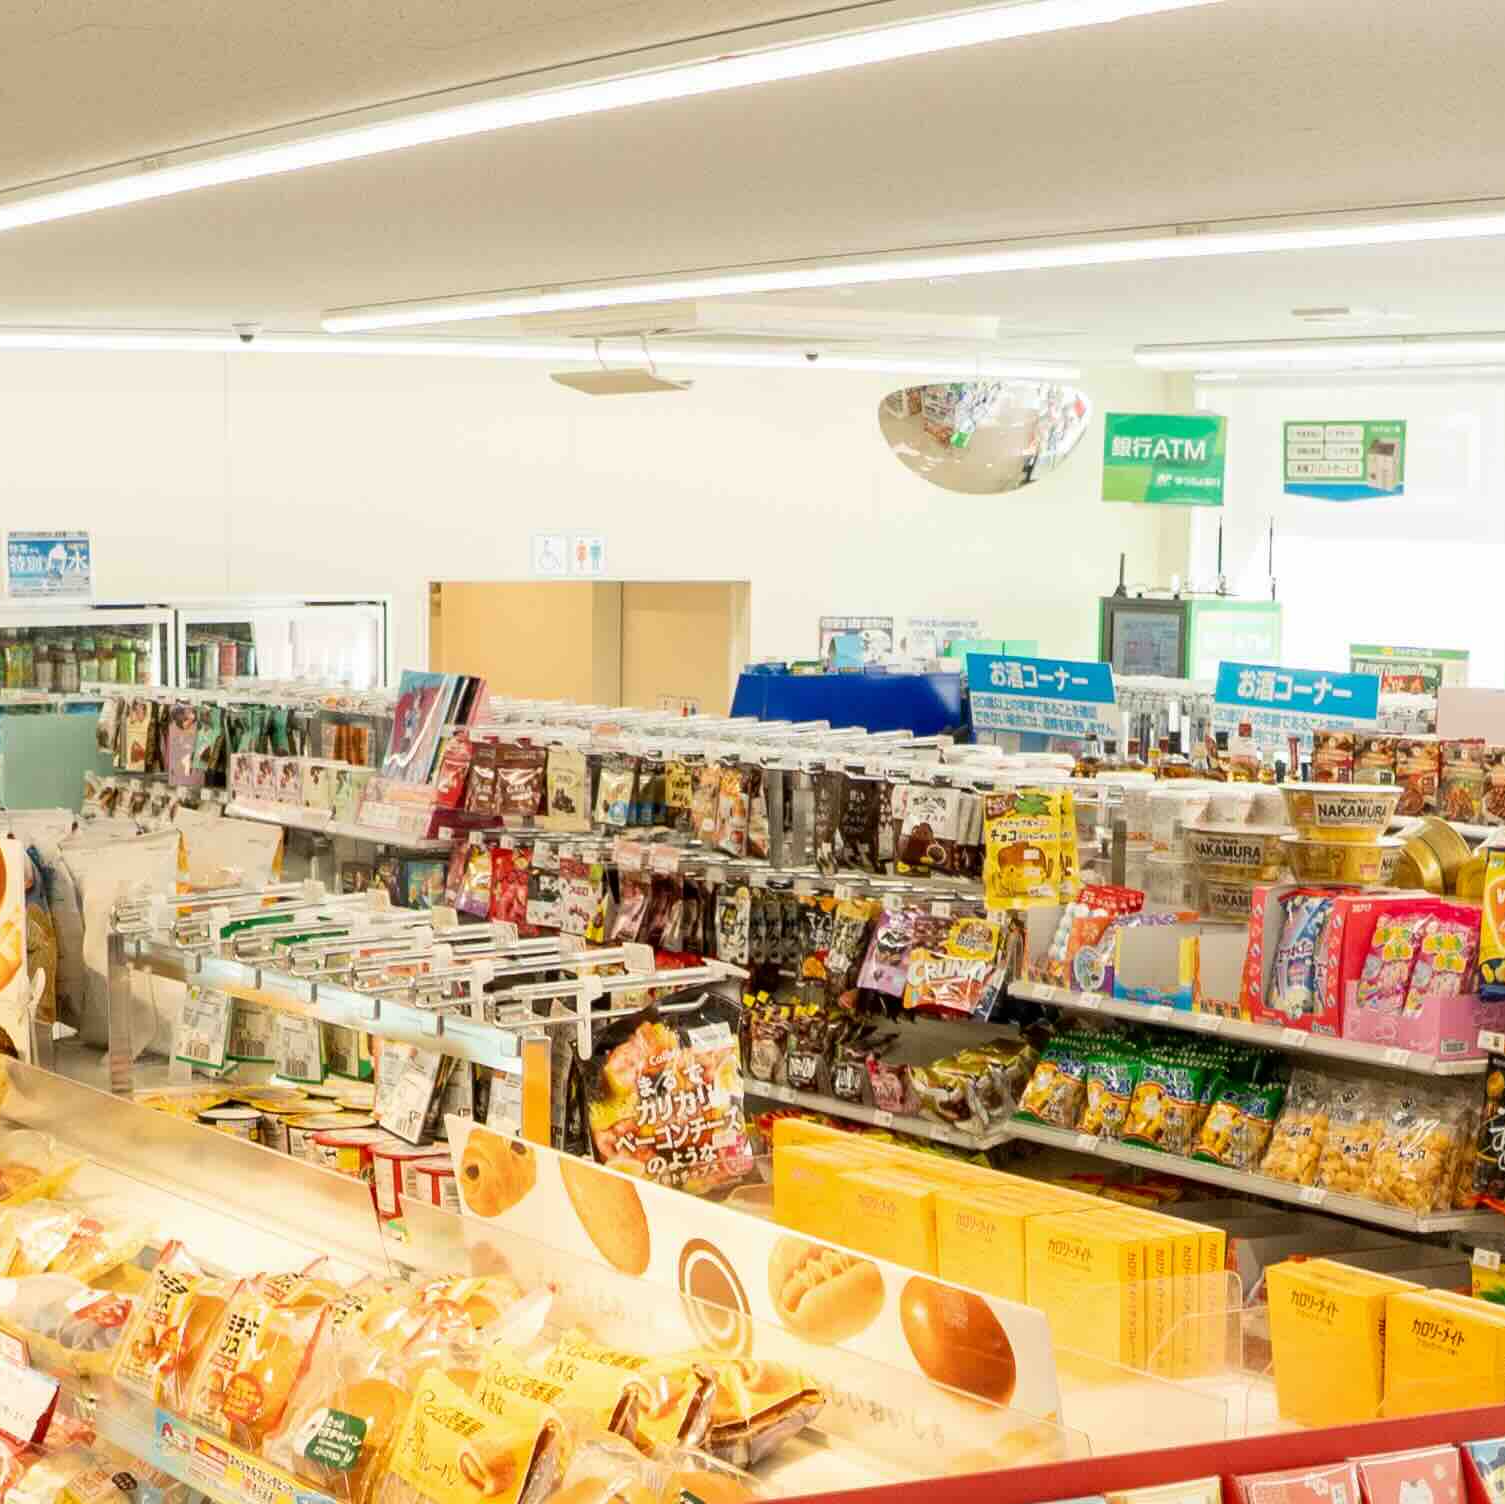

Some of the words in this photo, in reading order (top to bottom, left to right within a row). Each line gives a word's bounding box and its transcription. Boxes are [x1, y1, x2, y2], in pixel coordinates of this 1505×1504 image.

[1112, 436, 1206, 461] 銀行ATM
[990, 660, 1088, 692] お酒コーナー
[1237, 671, 1352, 705] お酒コーナー
[1317, 803, 1387, 818] NAKAMURA
[615, 1105, 744, 1152] ベーコンチーズ
[648, 1143, 717, 1173] のような
[1046, 1239, 1094, 1261] カロリーメイト
[1290, 1289, 1341, 1320] カロリーメイト
[1410, 1318, 1466, 1347] カロリーメイト
